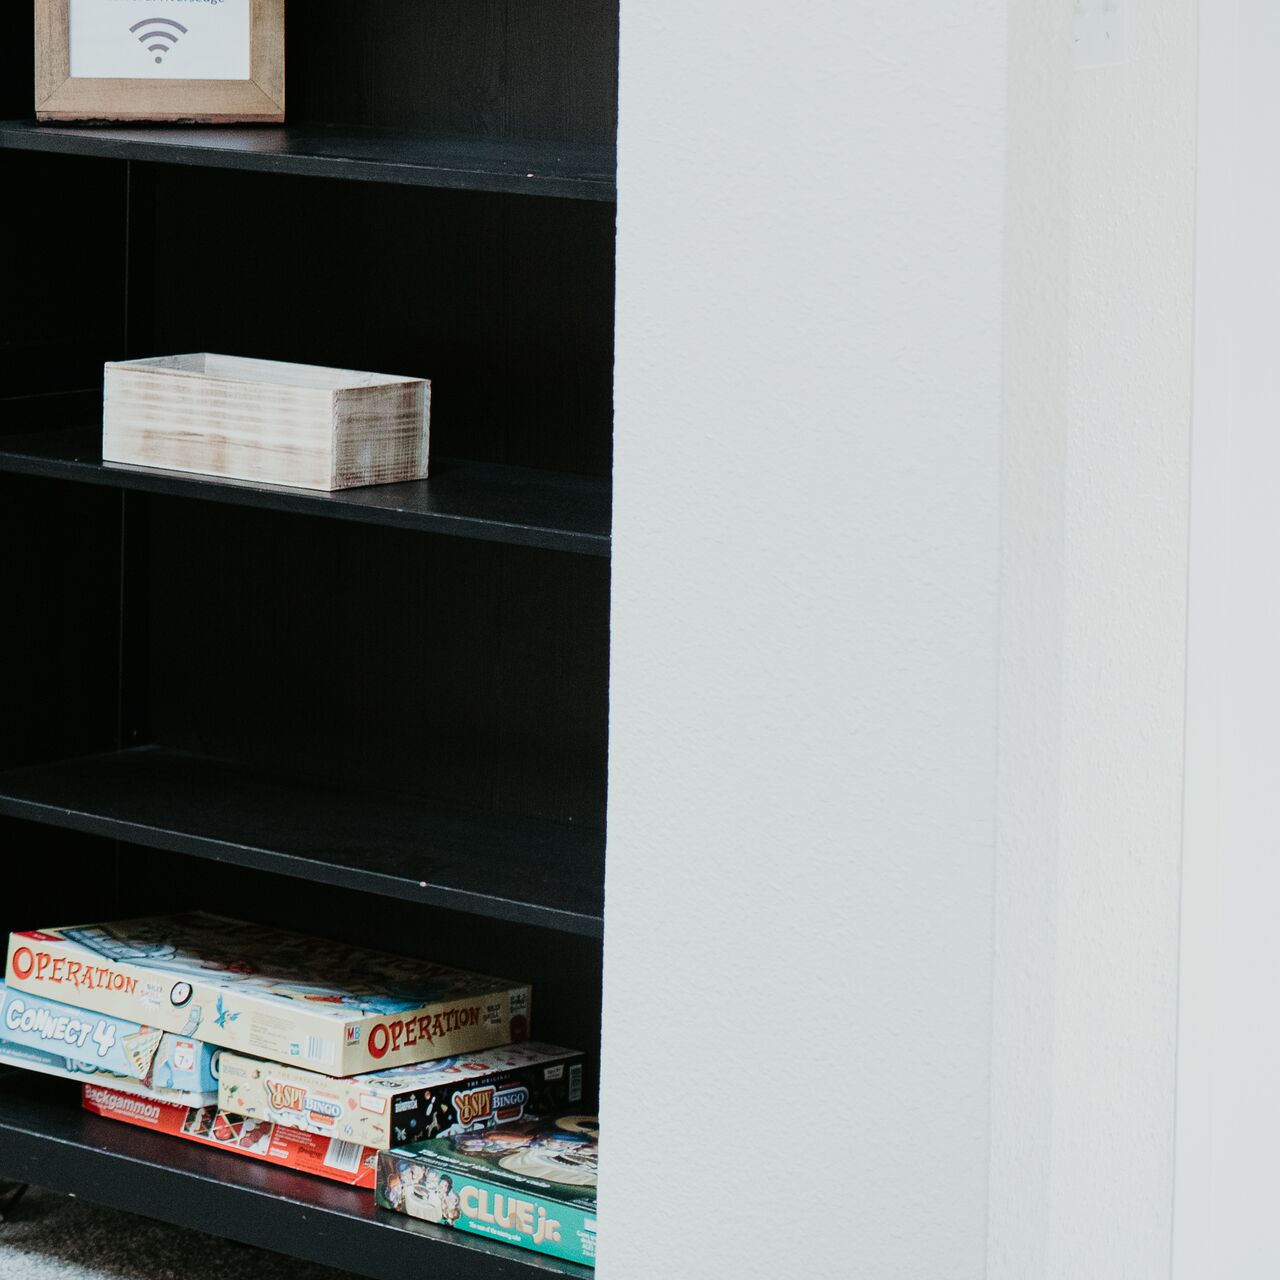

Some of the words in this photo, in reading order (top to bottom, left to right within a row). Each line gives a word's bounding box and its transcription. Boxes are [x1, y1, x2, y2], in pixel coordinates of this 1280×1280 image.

[12, 946, 140, 994] OPERATION
[6, 999, 93, 1048] CONNECT
[92, 1020, 117, 1057] 4
[347, 1026, 361, 1040] MB
[368, 1006, 481, 1059] OPERATION
[85, 1084, 161, 1118] Backgammon
[283, 1084, 307, 1111] SPY
[305, 1099, 341, 1116] BINGO
[472, 1090, 494, 1116] SPY
[493, 1092, 525, 1108] BINGO
[459, 1185, 535, 1233] CLUE
[532, 1206, 561, 1245] jr.
